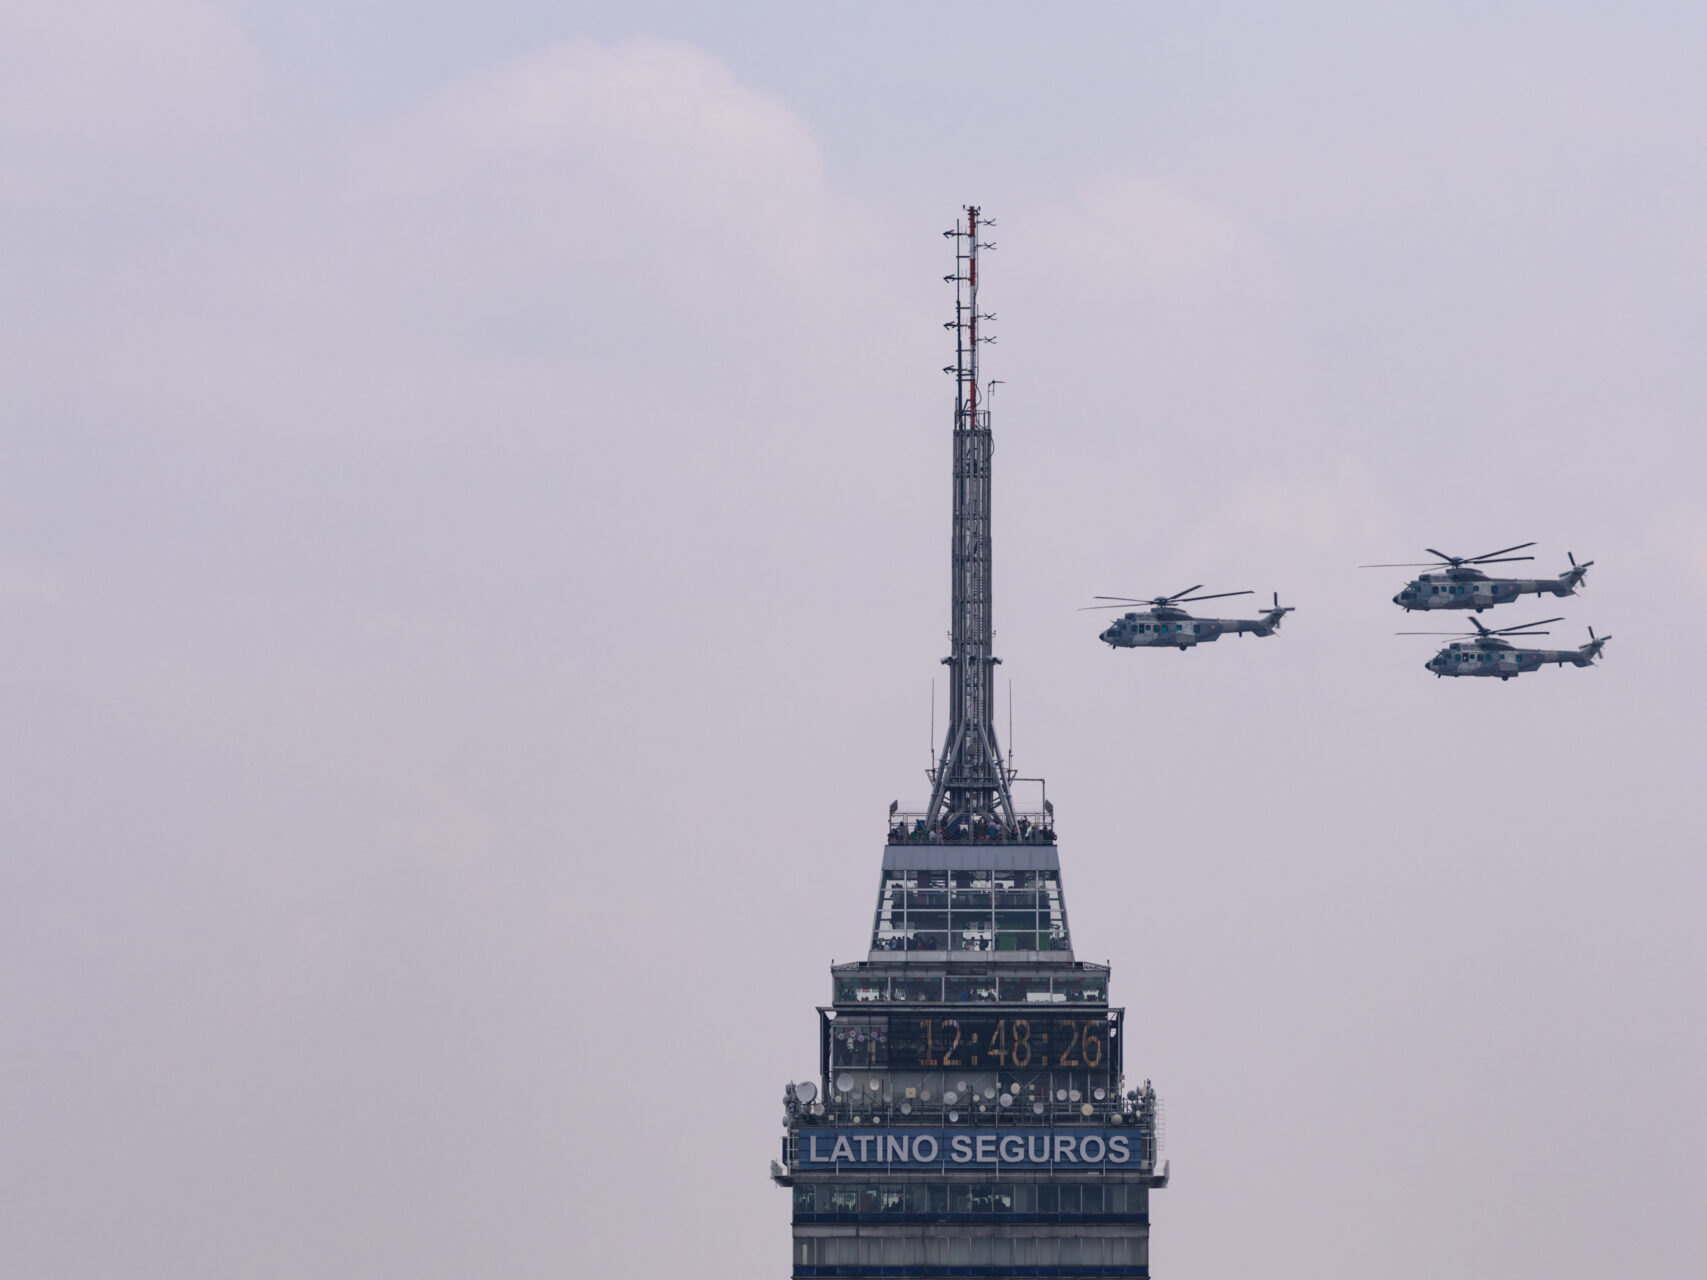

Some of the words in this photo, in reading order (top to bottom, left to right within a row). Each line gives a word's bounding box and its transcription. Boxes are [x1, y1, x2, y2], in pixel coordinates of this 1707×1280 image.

[920, 1019, 1101, 1066] 12:48:26
[809, 1135, 938, 1162] LATINO
[951, 1135, 1130, 1163] SEGUROS
